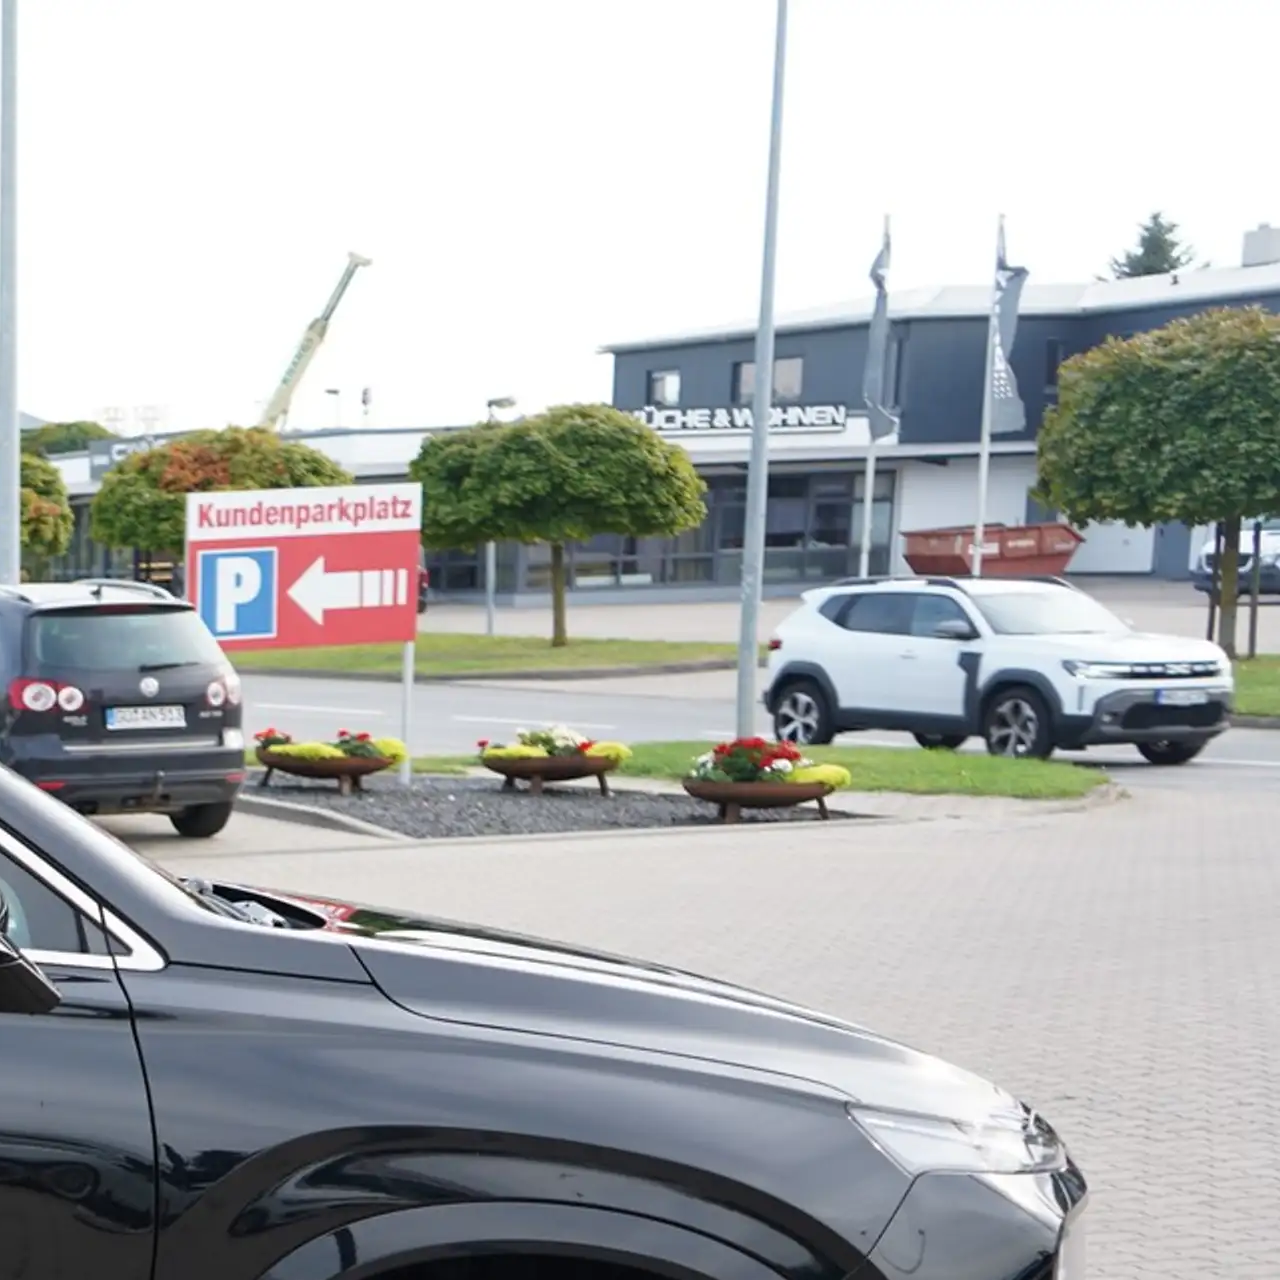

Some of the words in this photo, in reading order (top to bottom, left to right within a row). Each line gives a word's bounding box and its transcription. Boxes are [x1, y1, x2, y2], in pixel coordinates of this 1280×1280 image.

[712, 408, 732, 429] &
[197, 496, 413, 529] Kundenparkplatz
[215, 555, 263, 633] P
